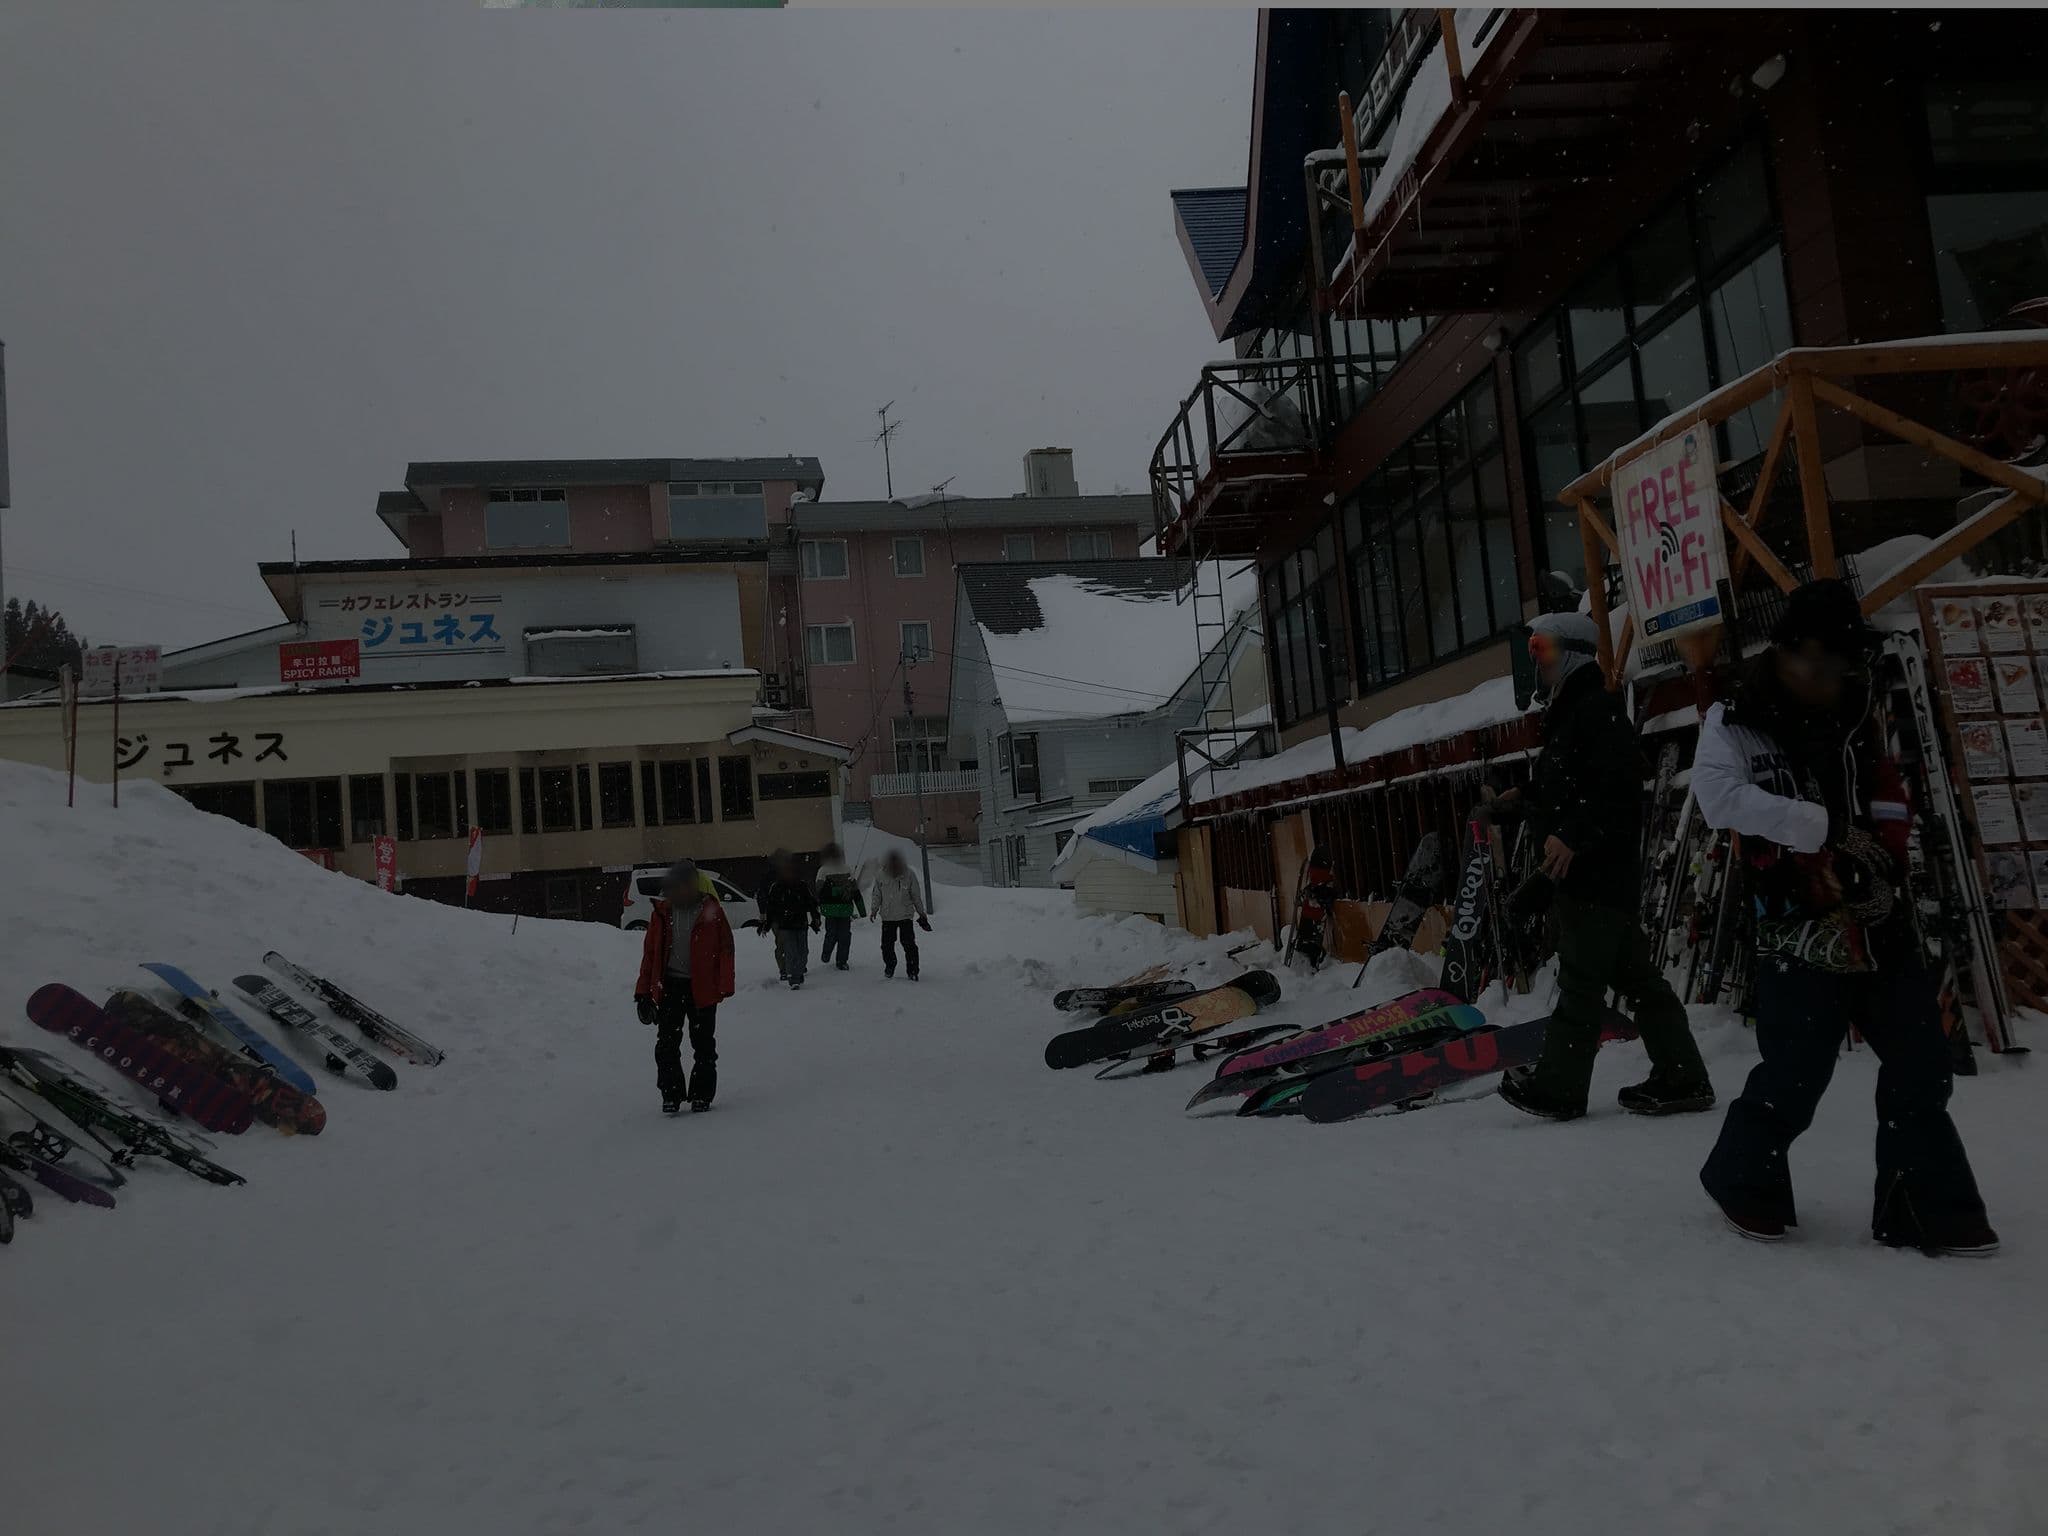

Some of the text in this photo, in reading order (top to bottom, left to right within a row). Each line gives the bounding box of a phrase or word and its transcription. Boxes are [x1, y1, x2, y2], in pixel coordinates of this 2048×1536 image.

[1626, 458, 1700, 546] FREE
[1635, 531, 1711, 610] Wi-Fi
[341, 592, 469, 611] カフェレストラン
[361, 613, 502, 648] ジュネス
[283, 665, 356, 679] SPICY RAMEN
[115, 732, 288, 770] ジュネス
